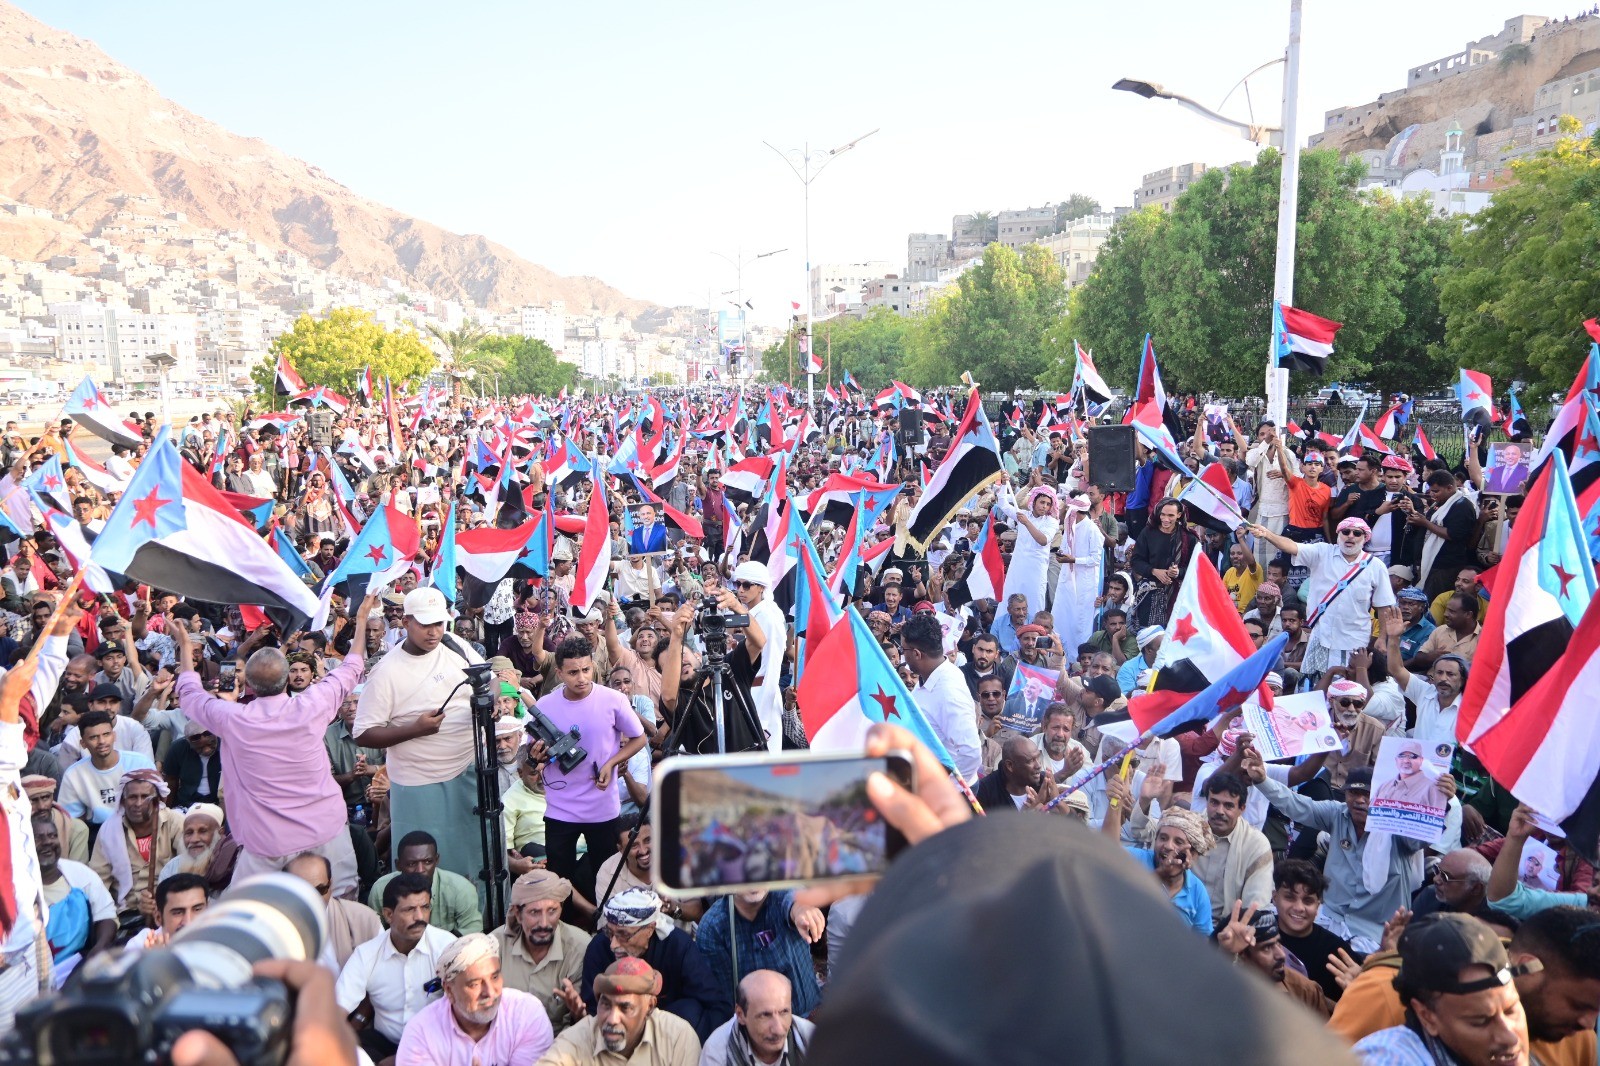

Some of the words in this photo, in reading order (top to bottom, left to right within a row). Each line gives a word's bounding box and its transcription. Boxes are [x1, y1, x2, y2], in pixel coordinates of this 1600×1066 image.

[1402, 803, 1426, 812] والشعب
[1427, 807, 1445, 816] القيادة
[1371, 808, 1400, 818] والسيادة
[1401, 811, 1420, 820] النصر
[1422, 815, 1443, 826] معادلة
